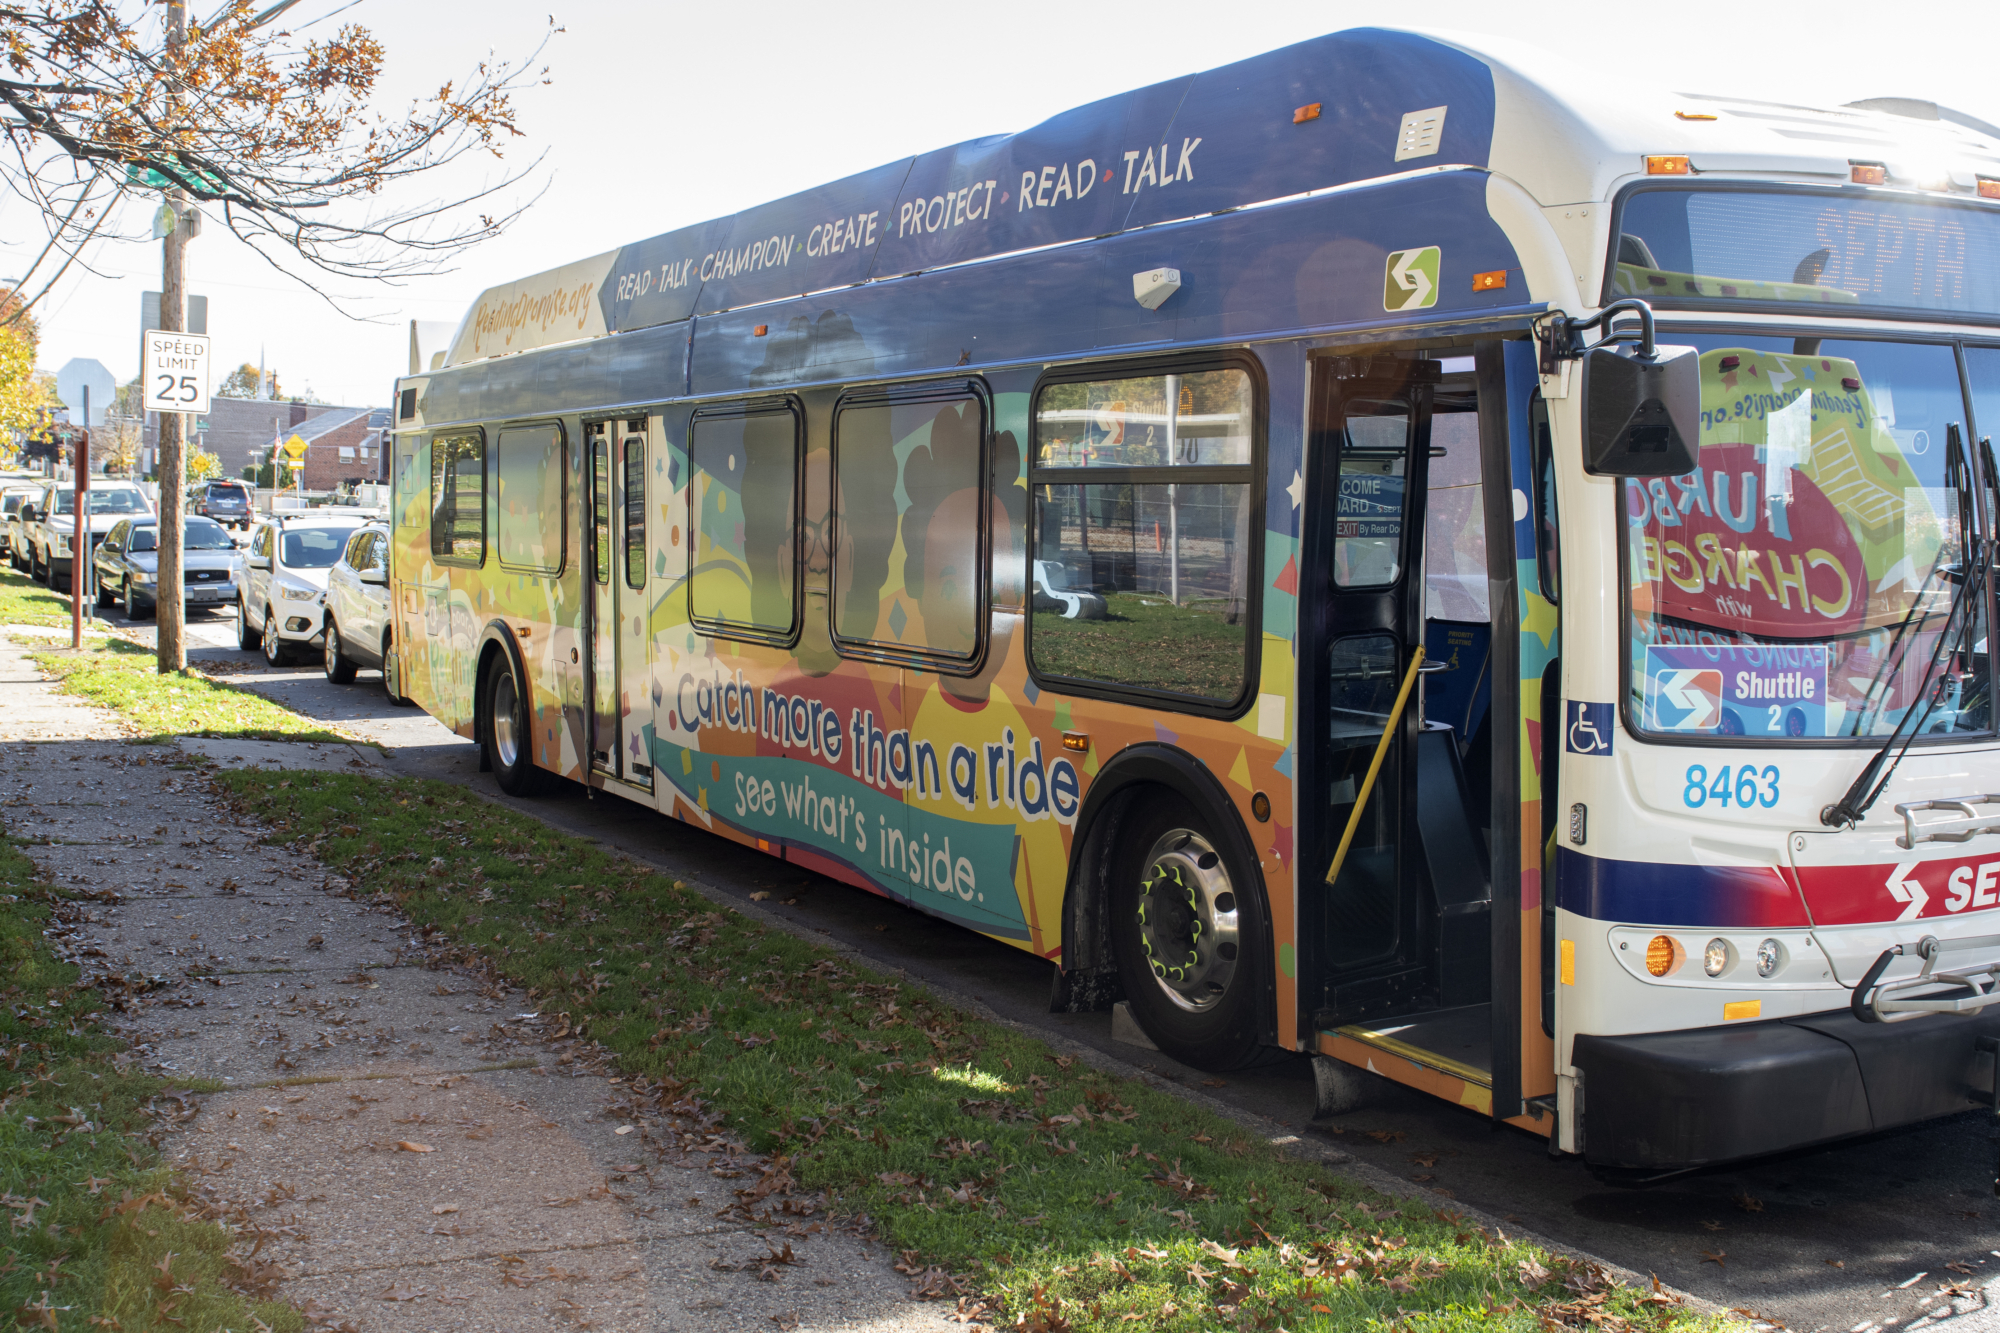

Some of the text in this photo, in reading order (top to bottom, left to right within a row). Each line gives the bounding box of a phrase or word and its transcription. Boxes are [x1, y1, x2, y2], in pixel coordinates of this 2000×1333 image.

[616, 137, 1202, 302] READ TALK CHAMPION CREATE PROTECT READ TALK
[1813, 208, 1966, 298] SEPTA
[473, 282, 593, 353] ReadingPromise.org
[153, 340, 204, 356] SPEED
[157, 356, 198, 370] LIMIT
[156, 374, 198, 402] 25
[1145, 425, 1154, 447] 2
[1339, 480, 1381, 495] COME
[1336, 522, 1358, 535] EXIT
[1360, 524, 1369, 535] By
[1371, 524, 1388, 534] Rear
[1447, 638, 1472, 647] SEATING
[1448, 630, 1474, 639] PRIORITY
[1735, 671, 1815, 700] Shuttle
[1767, 704, 1782, 731] 2
[677, 668, 1081, 826] Catch more than a ride
[1683, 764, 1781, 809] 8463
[780, 775, 867, 853] what's
[879, 814, 984, 902] inside.
[1944, 861, 2000, 912] SE
